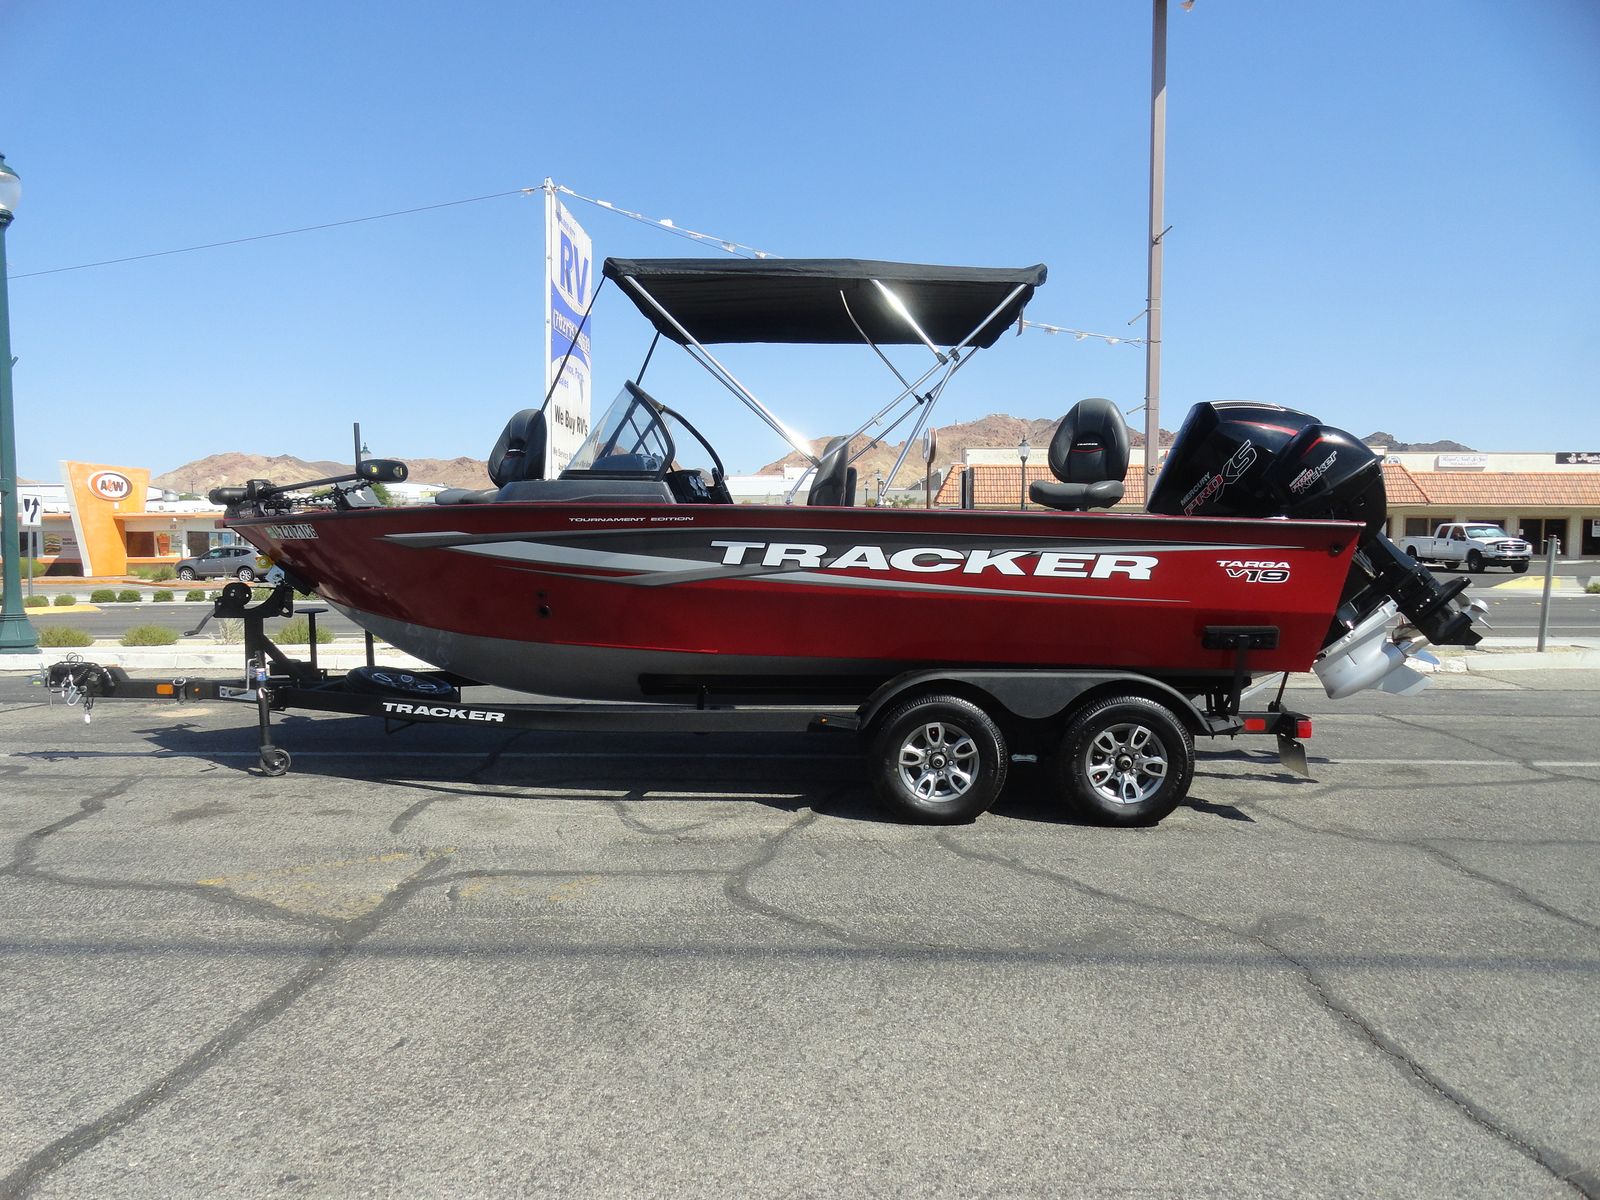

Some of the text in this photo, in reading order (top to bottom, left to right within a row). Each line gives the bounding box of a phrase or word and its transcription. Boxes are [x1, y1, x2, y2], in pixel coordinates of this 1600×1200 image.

[560, 229, 589, 308] RV
[554, 405, 588, 437] We Buy RV's
[100, 479, 124, 492] A&W
[1180, 471, 1211, 507] MERCURY
[710, 540, 1159, 581] TRACKER
[1216, 560, 1291, 569] TARGA
[1226, 569, 1291, 583] V19
[382, 702, 506, 722] TRACKER
